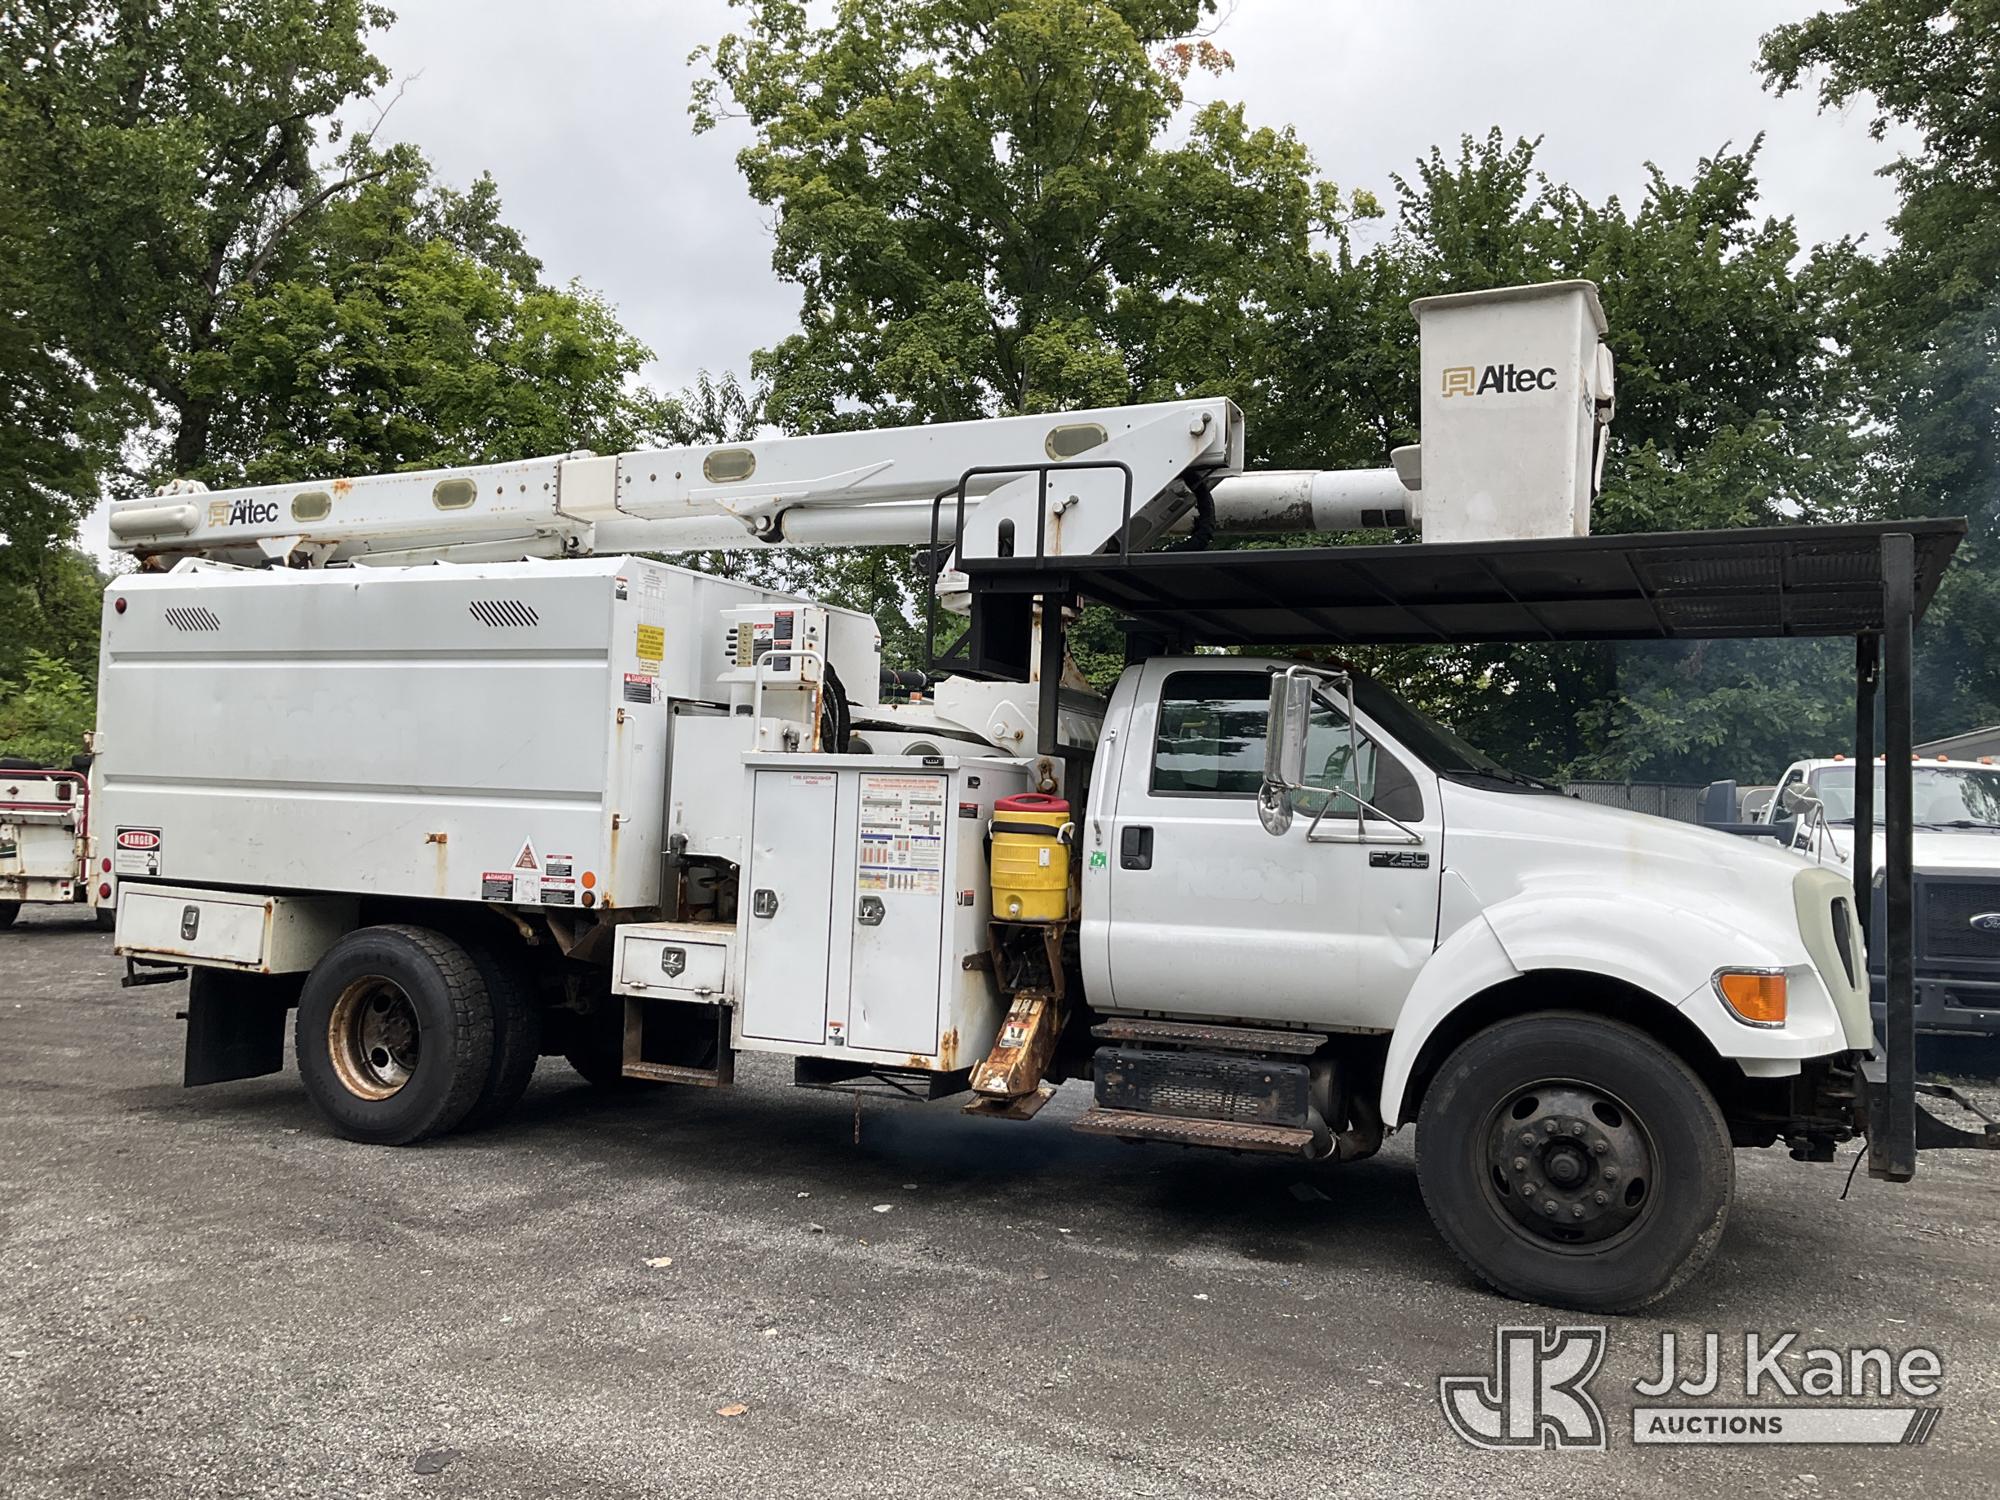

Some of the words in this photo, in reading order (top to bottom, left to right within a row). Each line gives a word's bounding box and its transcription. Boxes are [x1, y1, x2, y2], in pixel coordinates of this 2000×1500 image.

[1476, 364, 1557, 395] Altec
[229, 499, 278, 525] Altec
[124, 834, 153, 845] DANGER
